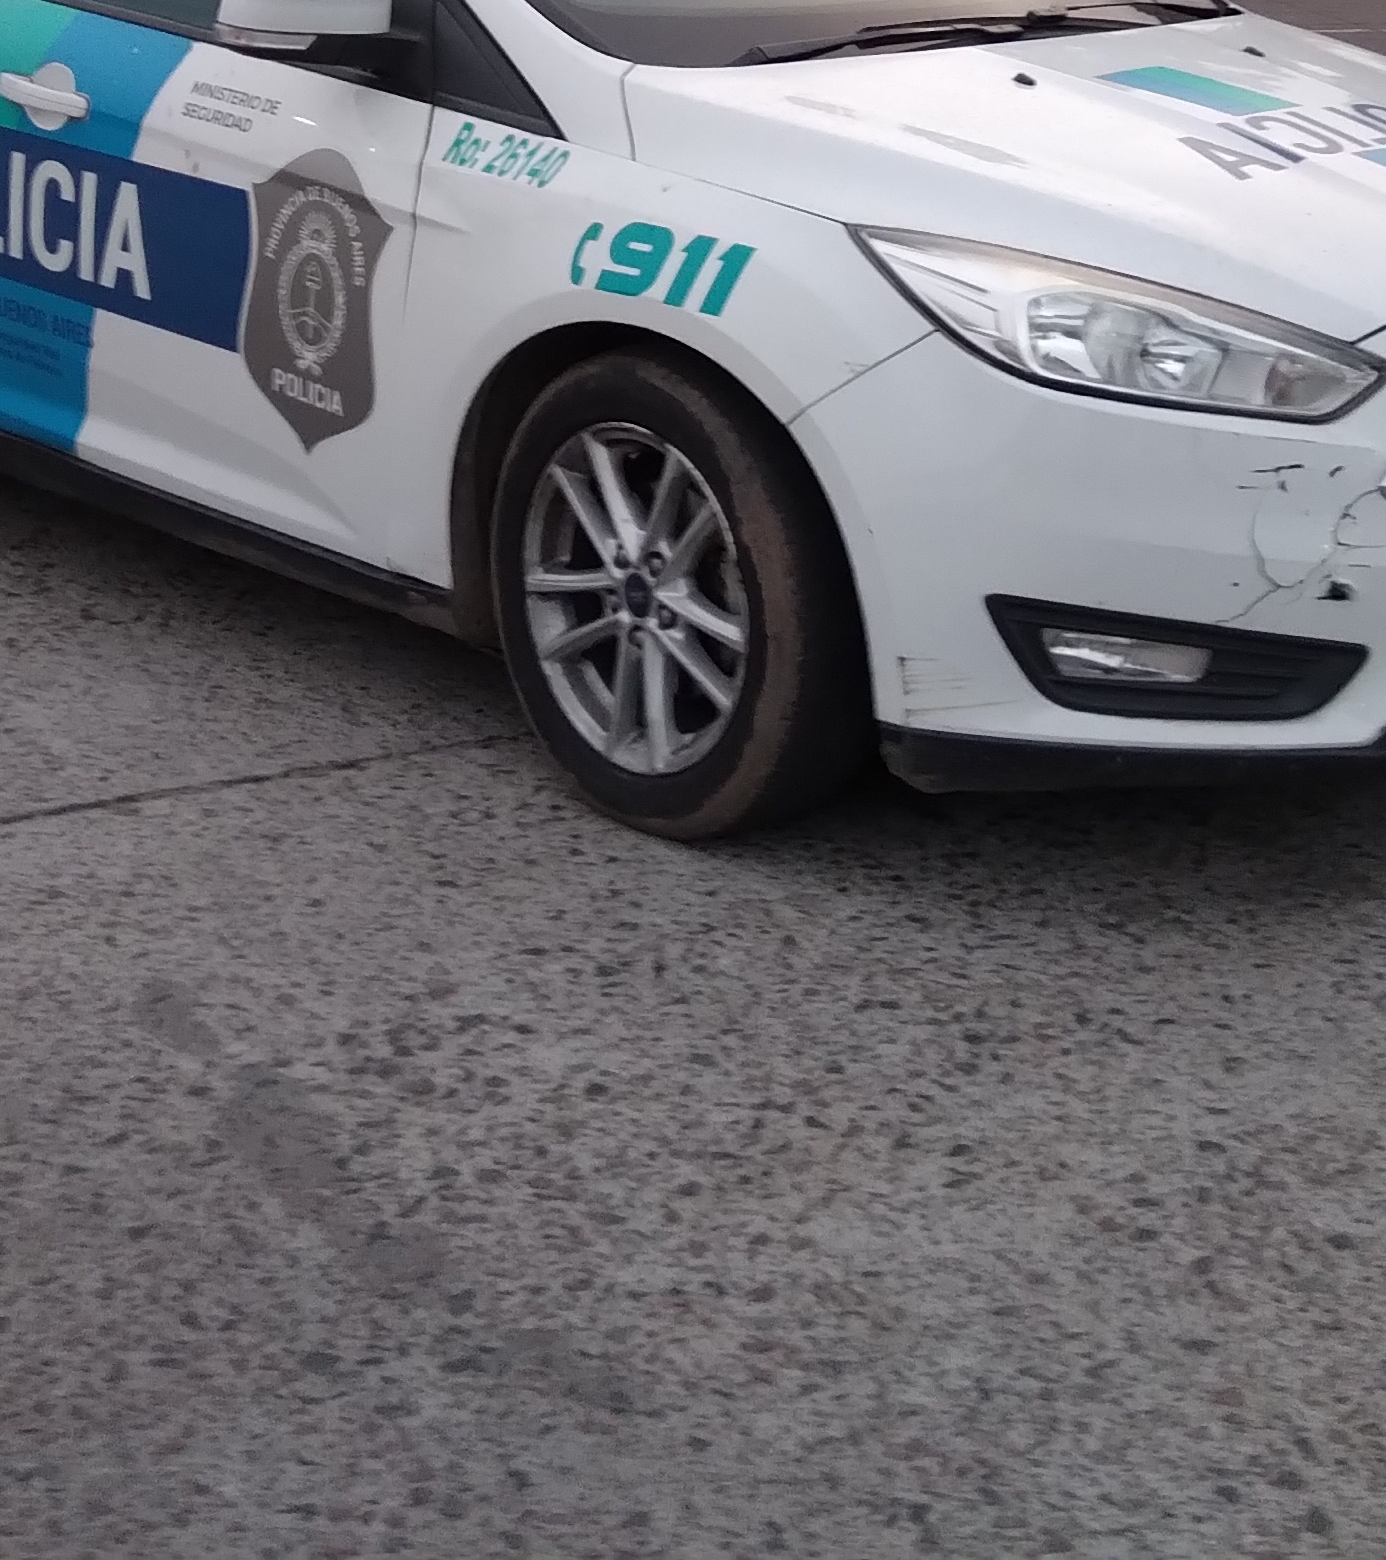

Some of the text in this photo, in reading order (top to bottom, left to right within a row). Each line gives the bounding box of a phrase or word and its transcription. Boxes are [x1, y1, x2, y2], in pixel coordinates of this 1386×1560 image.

[181, 102, 253, 133] SEGURIDAD
[191, 81, 282, 116] MINISTERIO DE
[480, 134, 571, 188] 26140
[264, 190, 307, 260] PROVINCIA
[305, 185, 324, 201] DE
[349, 240, 366, 287] AIRES
[594, 221, 759, 318] 911
[51, 314, 93, 348] AIRES
[270, 366, 345, 417] POLICIA
